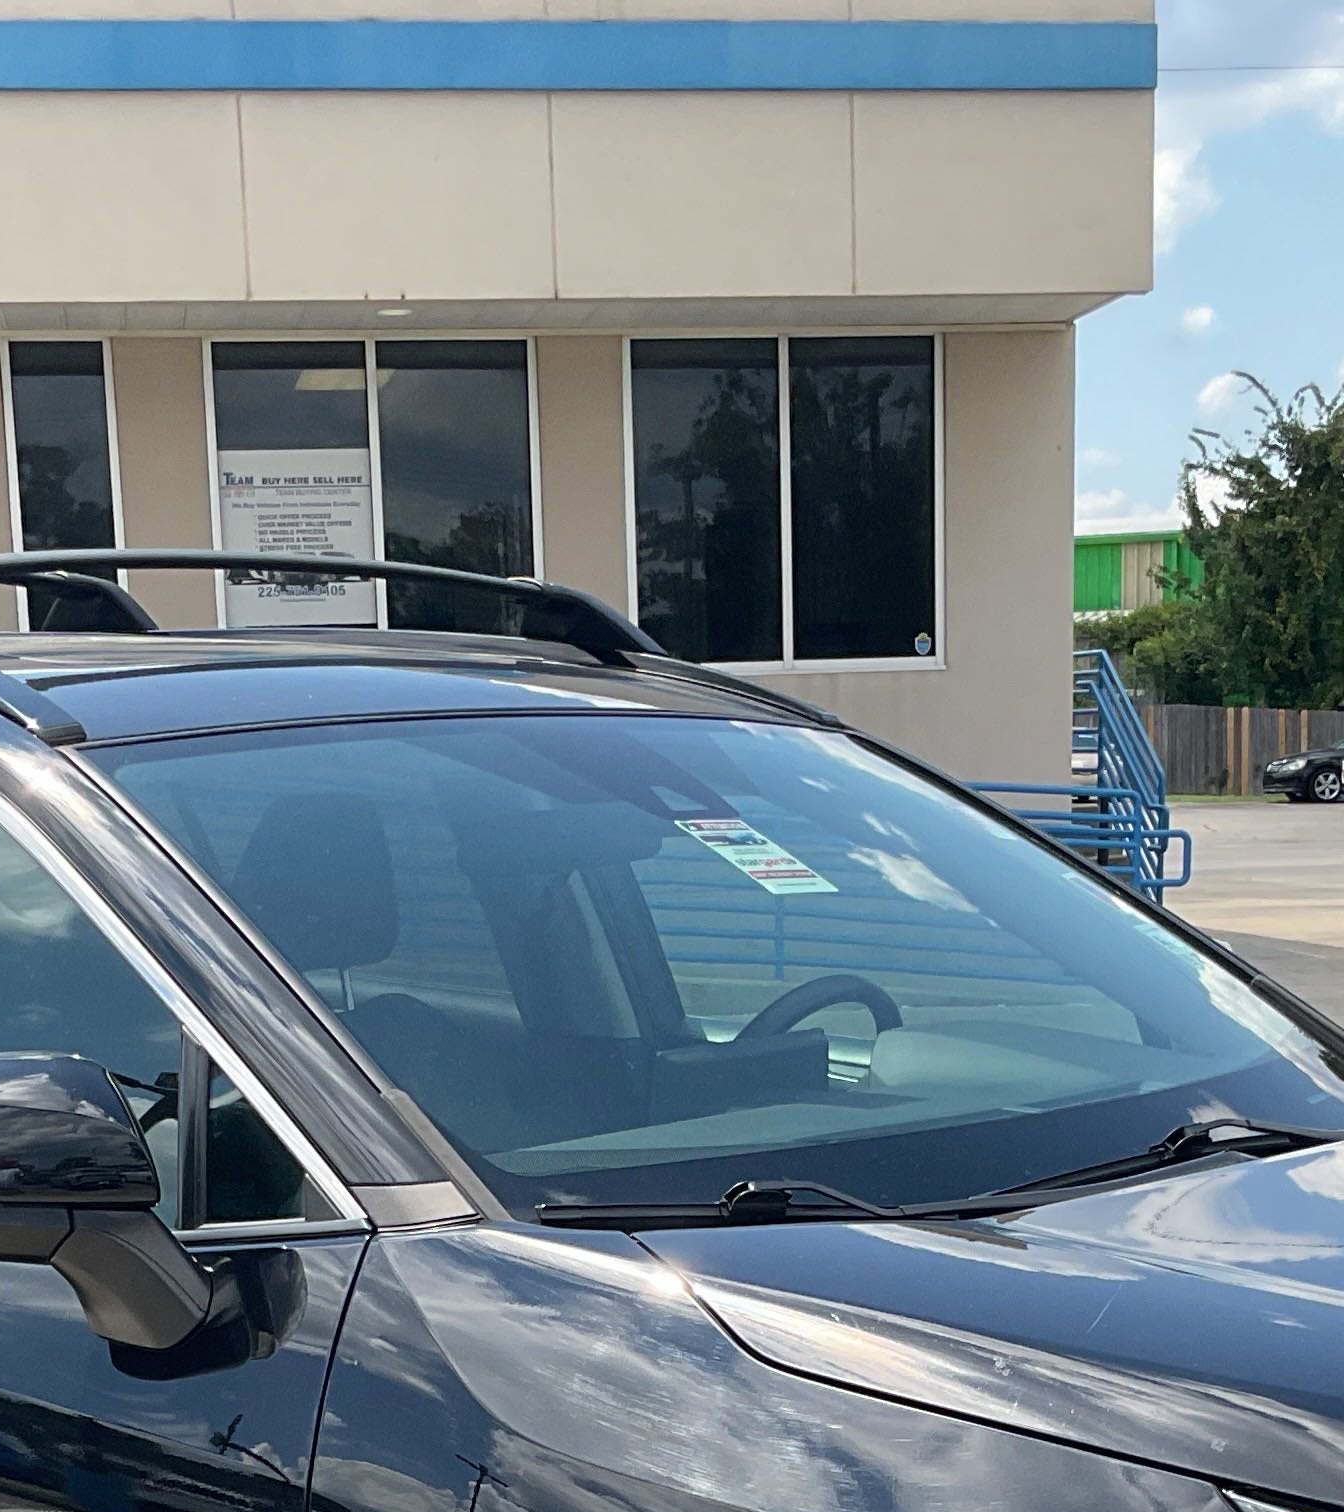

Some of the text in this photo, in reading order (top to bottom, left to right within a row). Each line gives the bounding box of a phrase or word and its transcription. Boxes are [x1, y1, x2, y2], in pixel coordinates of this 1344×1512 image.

[261, 476, 363, 485] BUY HERE SELL HERE
